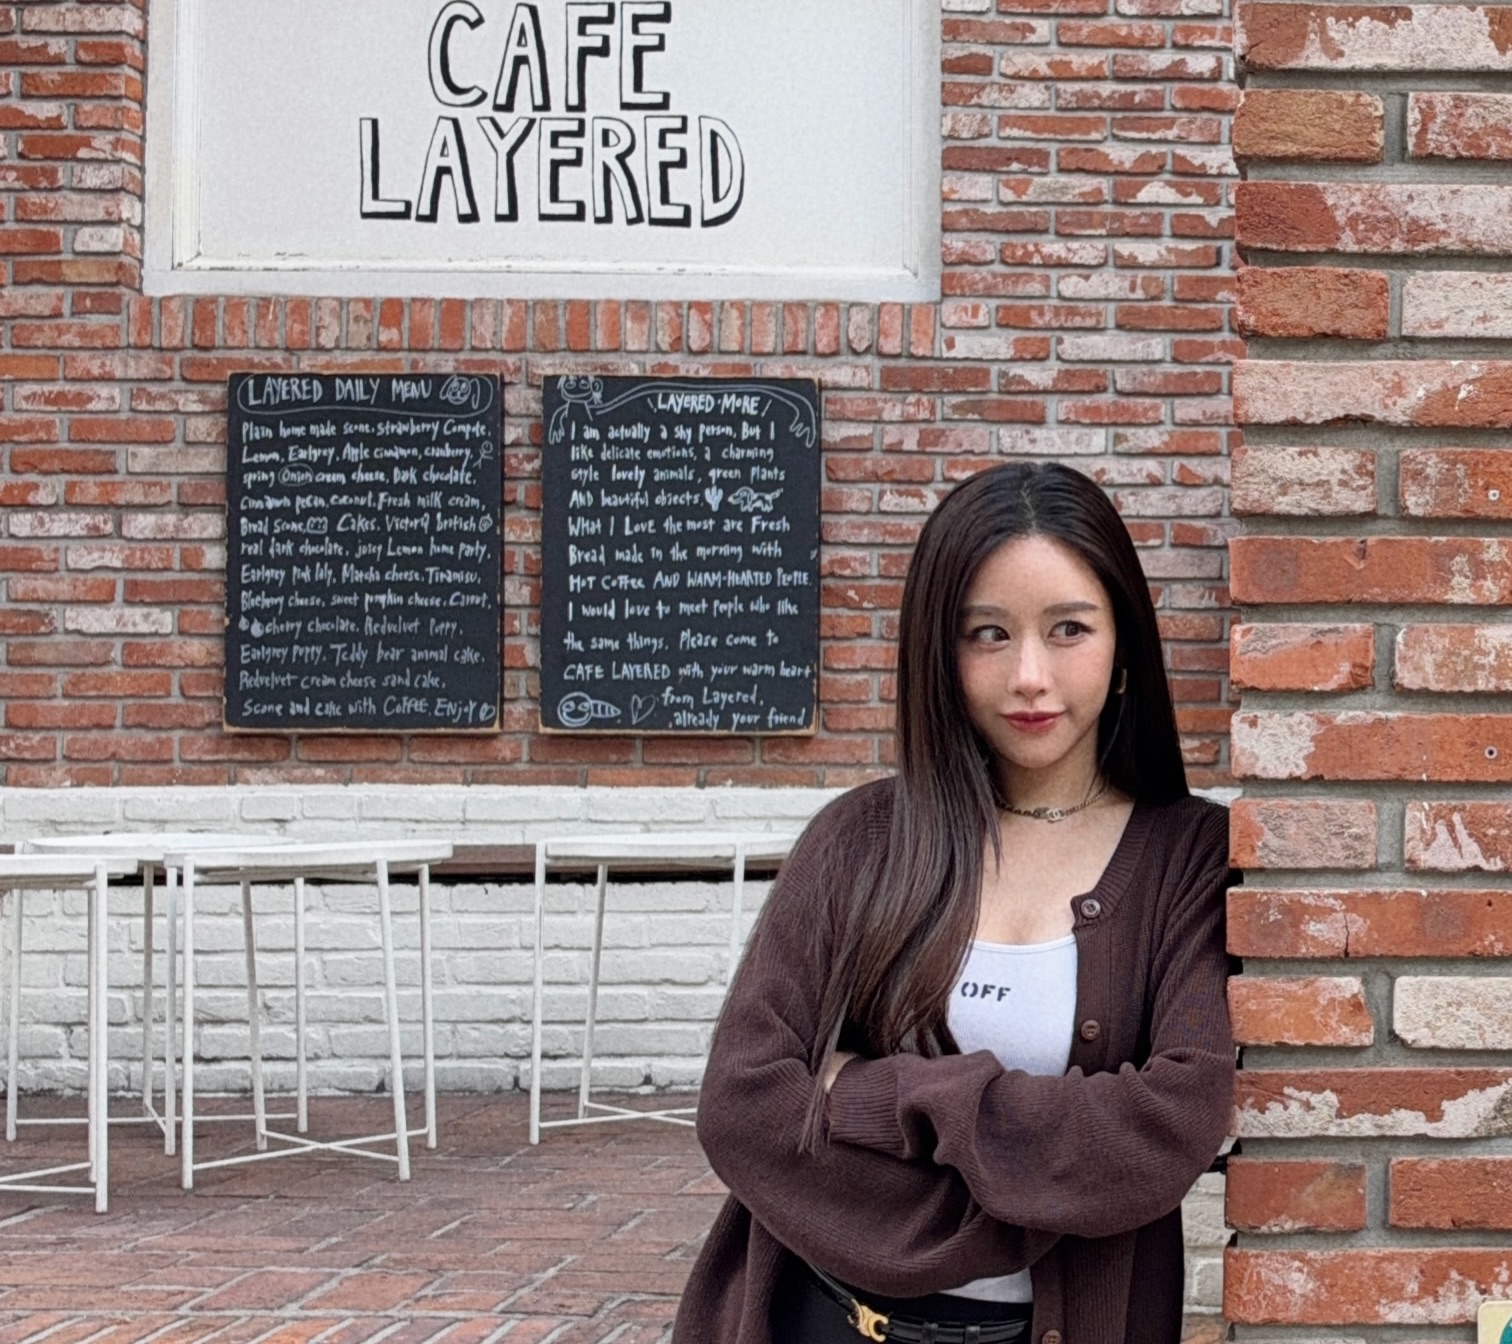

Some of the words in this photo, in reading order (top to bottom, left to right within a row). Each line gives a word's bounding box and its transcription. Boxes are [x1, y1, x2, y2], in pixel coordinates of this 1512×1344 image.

[428, 0, 671, 112] CAFE
[360, 115, 745, 228] LAYERED
[248, 376, 323, 406] LAYERED
[336, 377, 381, 406] DAILY
[391, 377, 433, 403] MENU
[242, 421, 273, 443] Plain
[279, 420, 306, 437] home
[309, 420, 336, 438] made
[571, 420, 576, 441] I
[583, 424, 600, 441] am
[607, 422, 651, 444] actually
[659, 424, 669, 441] a
[674, 424, 693, 445] shy
[741, 420, 761, 441] But
[770, 420, 775, 441] I
[600, 442, 641, 462] delicate
[647, 445, 698, 462] emotions,
[704, 446, 712, 461] a
[721, 443, 774, 463] charming
[243, 470, 276, 489] spring
[571, 464, 600, 487] style
[611, 463, 647, 490] lovely
[708, 468, 742, 487] green
[377, 491, 411, 512] Fresh
[600, 487, 650, 510] beautiful
[610, 515, 615, 537] I
[663, 514, 683, 535] the
[686, 517, 717, 533] most
[723, 519, 744, 534] are
[750, 515, 791, 535] Fresh
[240, 538, 263, 556] real
[387, 536, 423, 556] Lemon
[568, 543, 606, 567] Bread
[615, 542, 644, 564] made
[651, 545, 663, 562] in
[669, 541, 688, 562] the
[696, 544, 744, 564] morning
[752, 539, 783, 558] with
[653, 569, 681, 590] AND
[569, 600, 574, 622] I
[581, 597, 616, 621] would
[624, 597, 651, 620] love
[656, 599, 671, 621] to
[679, 597, 709, 617] meet
[749, 595, 771, 614] who
[265, 617, 302, 640] cherry
[363, 615, 420, 636] Redvelvet
[563, 630, 585, 653] the
[590, 636, 620, 652] same
[679, 627, 719, 651] Please
[725, 633, 758, 648] come
[766, 628, 780, 647] to
[329, 641, 369, 669] Teddy
[239, 668, 299, 691] Redvelvet
[300, 673, 337, 689] cream
[340, 669, 377, 689] cheese
[381, 667, 410, 688] sand
[563, 662, 605, 682] CAFE
[611, 660, 671, 682] LAYERED
[678, 660, 704, 680] with
[711, 663, 740, 684] your
[742, 663, 776, 678] warm
[779, 659, 812, 679] heart
[241, 699, 284, 717] Scone
[289, 696, 310, 716] and
[348, 696, 376, 716] with
[661, 685, 694, 711] from
[673, 709, 720, 732] already
[732, 711, 762, 732] your
[769, 706, 806, 730] friend
[960, 981, 1012, 1002] OFF
